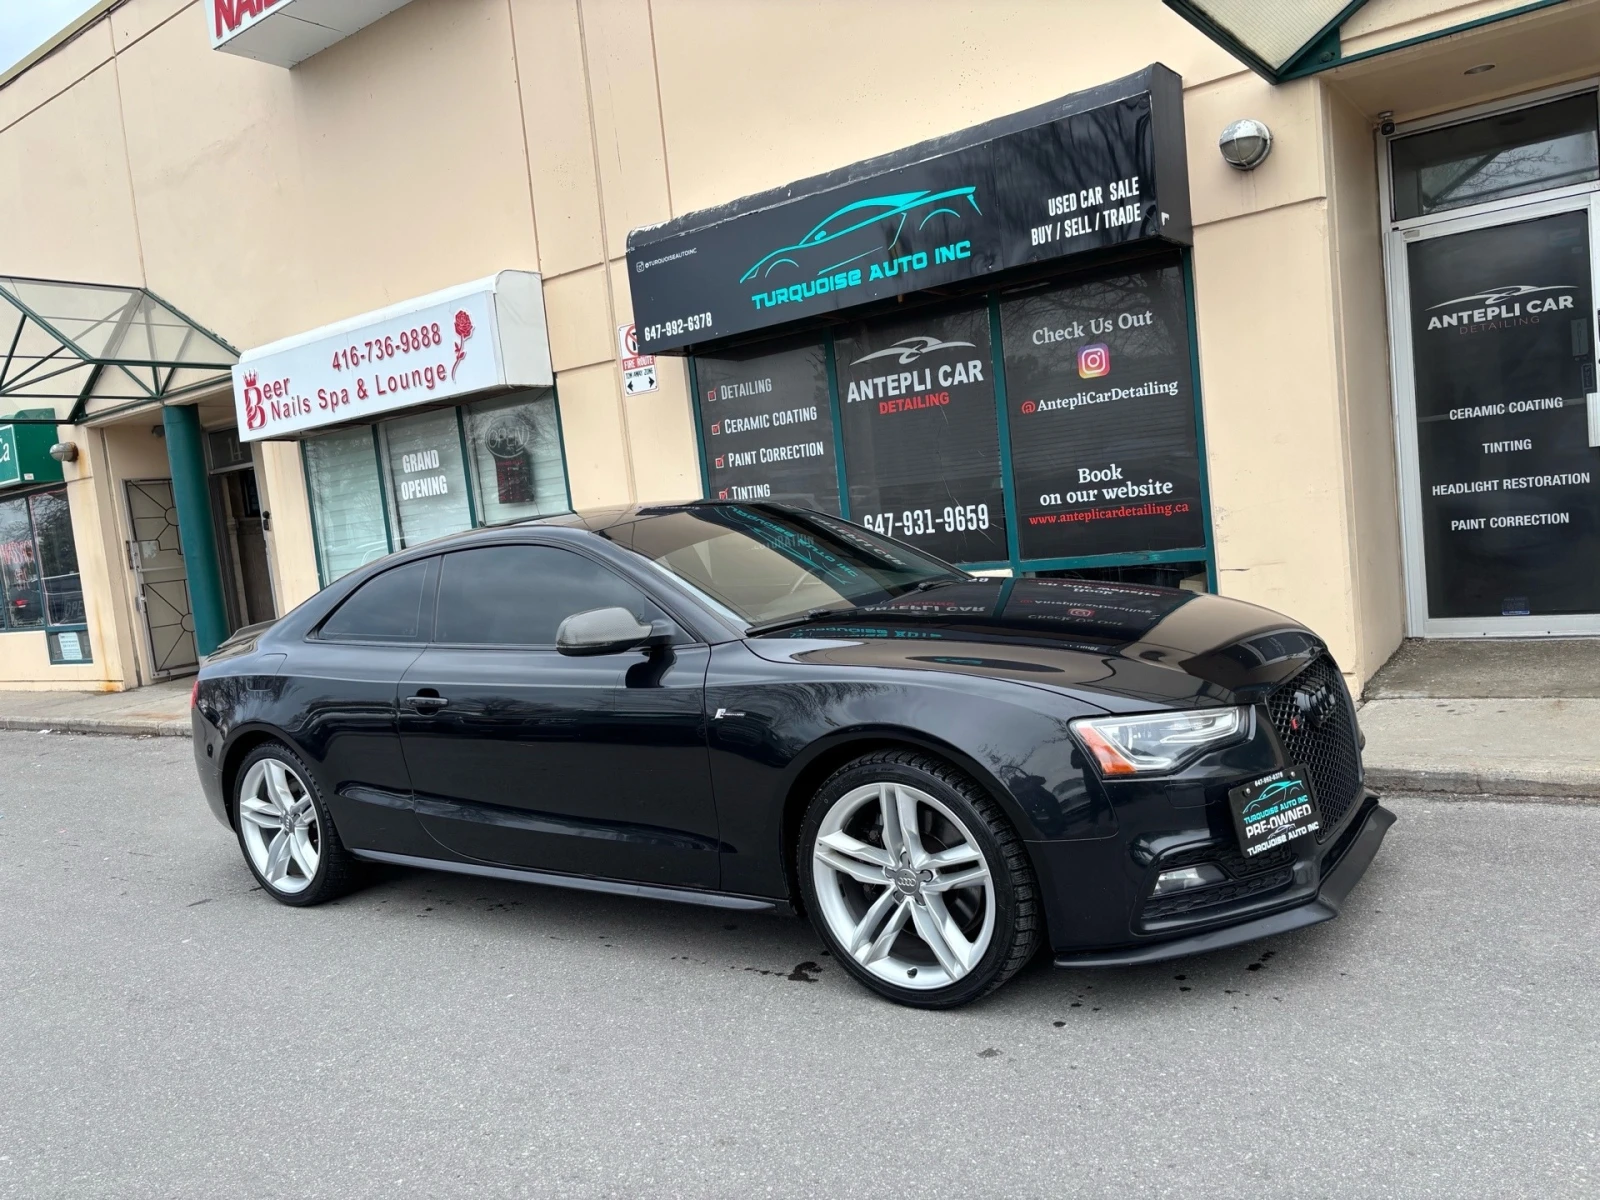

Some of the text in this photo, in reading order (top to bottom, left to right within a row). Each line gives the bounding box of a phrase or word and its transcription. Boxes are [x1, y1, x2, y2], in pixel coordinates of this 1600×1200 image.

[1048, 176, 1140, 216] USED CAR SALE
[1031, 224, 1053, 246] BUY
[1064, 215, 1092, 238] SELL
[1103, 203, 1141, 228] TRADE
[752, 240, 971, 309] TURQUOISE AUTO INC
[644, 311, 713, 342] 647-992-6378
[1427, 296, 1574, 330] ANTEPLI CAR
[1459, 316, 1540, 335] DETAILING
[1032, 310, 1153, 345] Check Us Out
[332, 322, 442, 371] 416-736-9888
[270, 363, 447, 421] Nails Spa & Lounge
[720, 378, 773, 400] DETAILING
[847, 359, 984, 403] ANTEPLI CAR
[879, 392, 949, 415] DETAILING
[1021, 381, 1178, 414] @AntepliCarDetailing
[1450, 397, 1563, 420] CERAMIC COATING
[724, 406, 817, 434] CERAMIC COATING
[728, 441, 824, 467] PAINT CORRECTION
[1482, 439, 1532, 454] TINTING
[402, 450, 440, 473] GRAND
[1077, 463, 1123, 483] Book
[401, 475, 448, 500] OPENING
[732, 484, 770, 500] TINTING
[1039, 479, 1173, 506] on our website
[1432, 472, 1590, 496] HEADLIGHT RESTORATION
[863, 504, 989, 537] 647-931-9659
[1029, 502, 1189, 525] www.anteplicardetailing.ca
[1451, 512, 1569, 531] PAINT CORRECTION
[1280, 798, 1297, 811] AUTO
[1298, 795, 1308, 804] INC
[1245, 804, 1311, 838] PRE-OWNED
[1247, 821, 1320, 856] TURQUOISE AUTO INC
